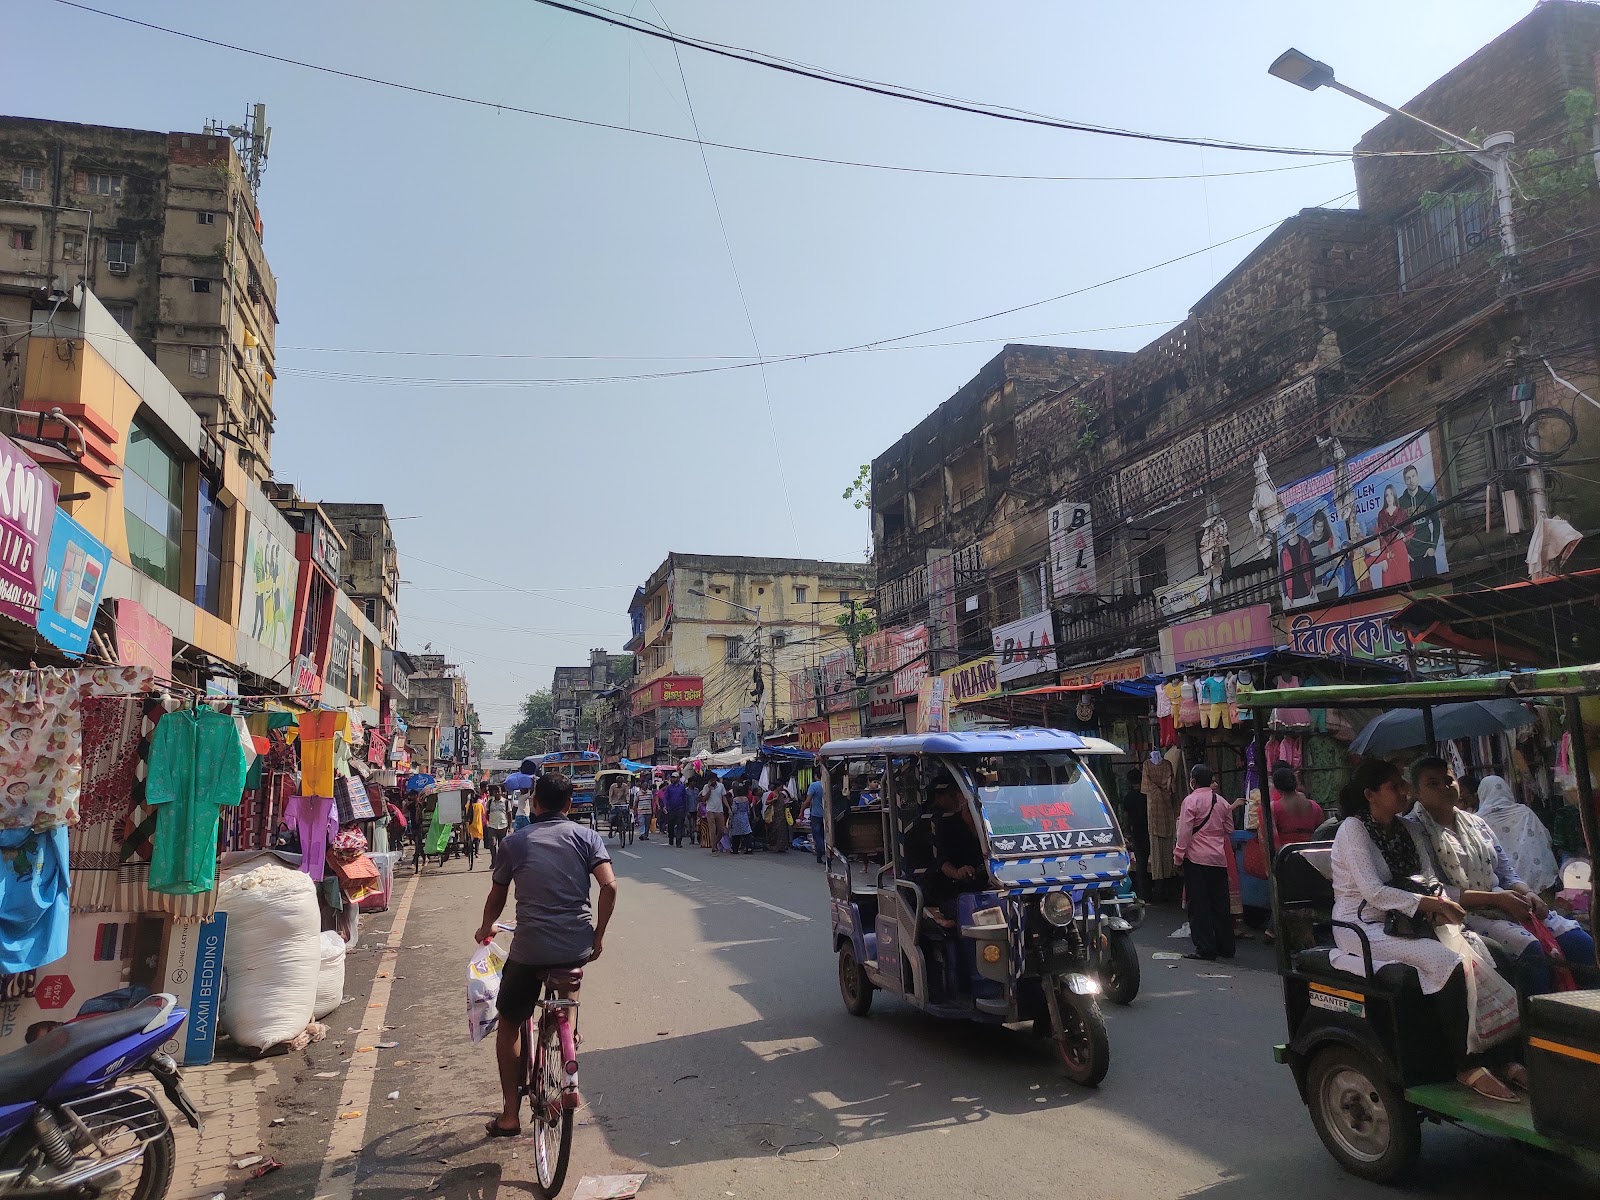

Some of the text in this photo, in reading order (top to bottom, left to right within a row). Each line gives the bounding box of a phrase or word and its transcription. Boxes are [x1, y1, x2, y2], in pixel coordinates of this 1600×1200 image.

[1019, 832, 1094, 851] AFIYA
[194, 935, 218, 1041] LAXMI BEDDING
[1309, 992, 1348, 1008] BASANTEE
